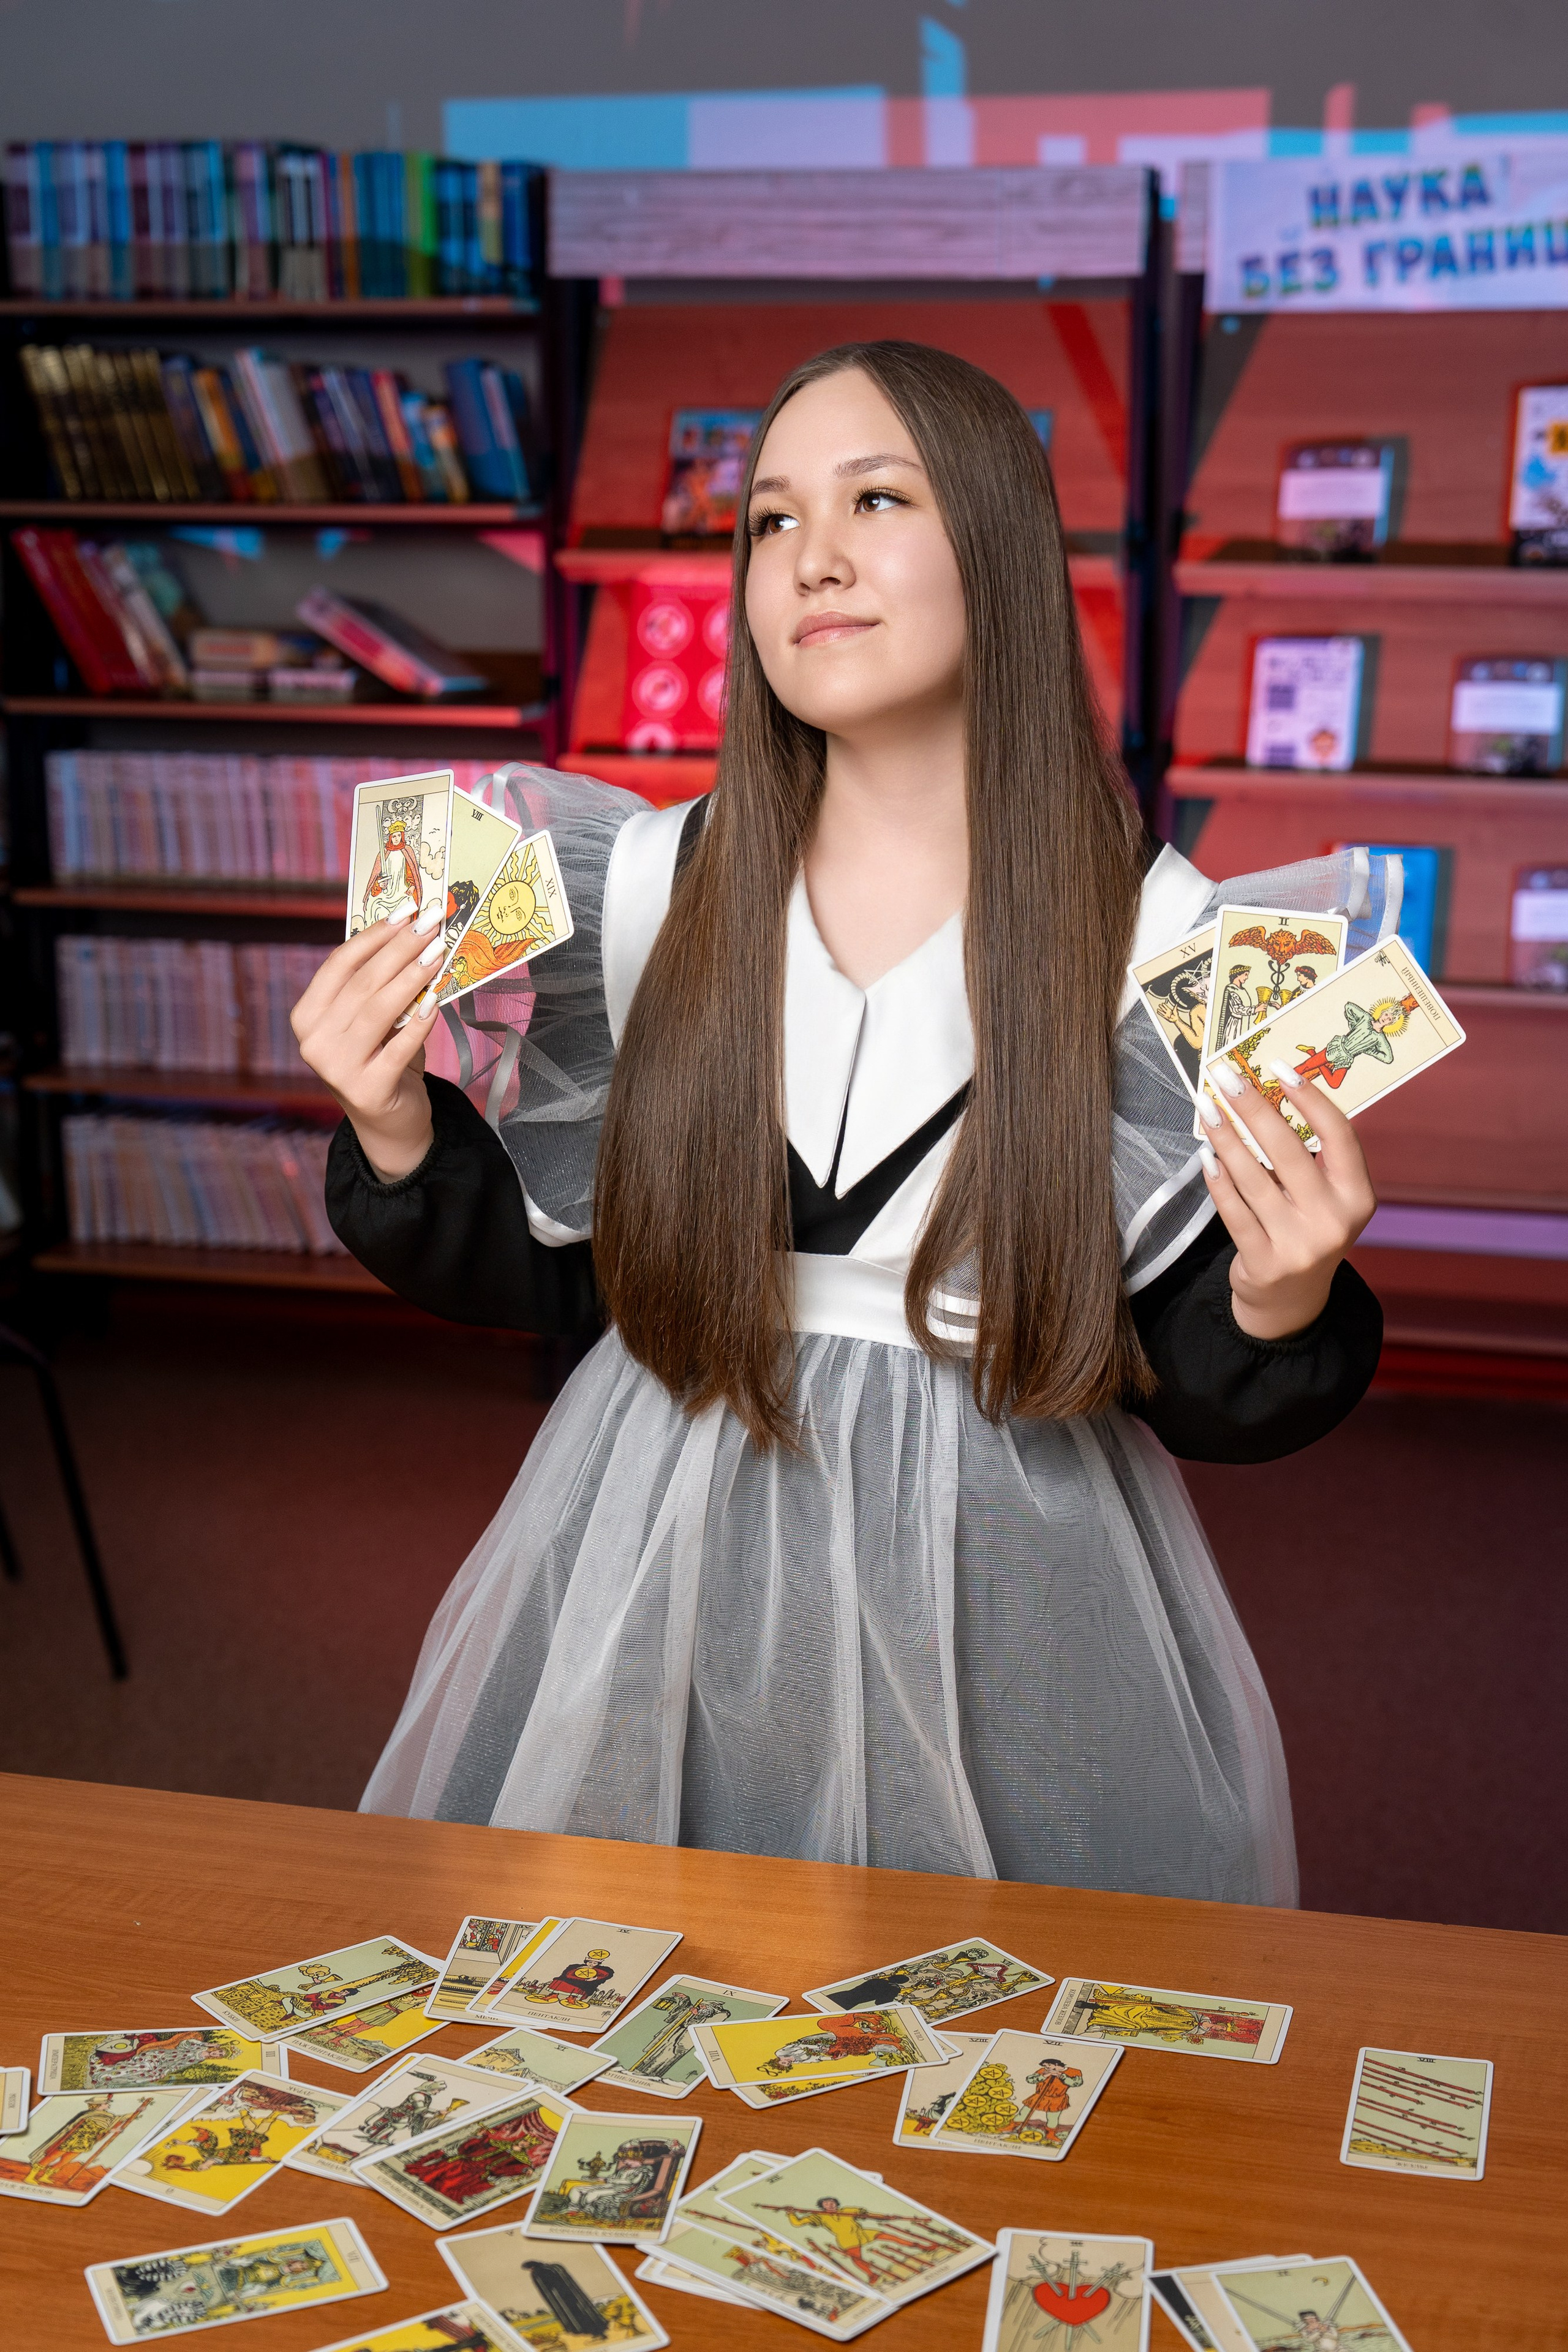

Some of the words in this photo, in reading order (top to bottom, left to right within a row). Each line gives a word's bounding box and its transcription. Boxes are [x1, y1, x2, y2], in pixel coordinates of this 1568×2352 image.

[1309, 164, 1490, 228] НАУКА
[1241, 247, 1340, 296] БЕЗ
[471, 809, 484, 822] VIII
[545, 878, 557, 899] XIX
[1278, 917, 1289, 926] II
[1180, 943, 1197, 959] XV
[1401, 966, 1441, 1021] ПОВЕШЕННЫЙ
[1063, 1988, 1076, 2010] КОРОЛЕВА
[222, 2010, 240, 2022] КУБКИ
[527, 2011, 570, 2022] ПЕНТАКЛИ
[1055, 2010, 1068, 2026] ЖЕЗЛОВ
[911, 2029, 924, 2041] СИЛА
[708, 2050, 720, 2062] VIII
[604, 2071, 650, 2087] ОТШЕЛЬНИК
